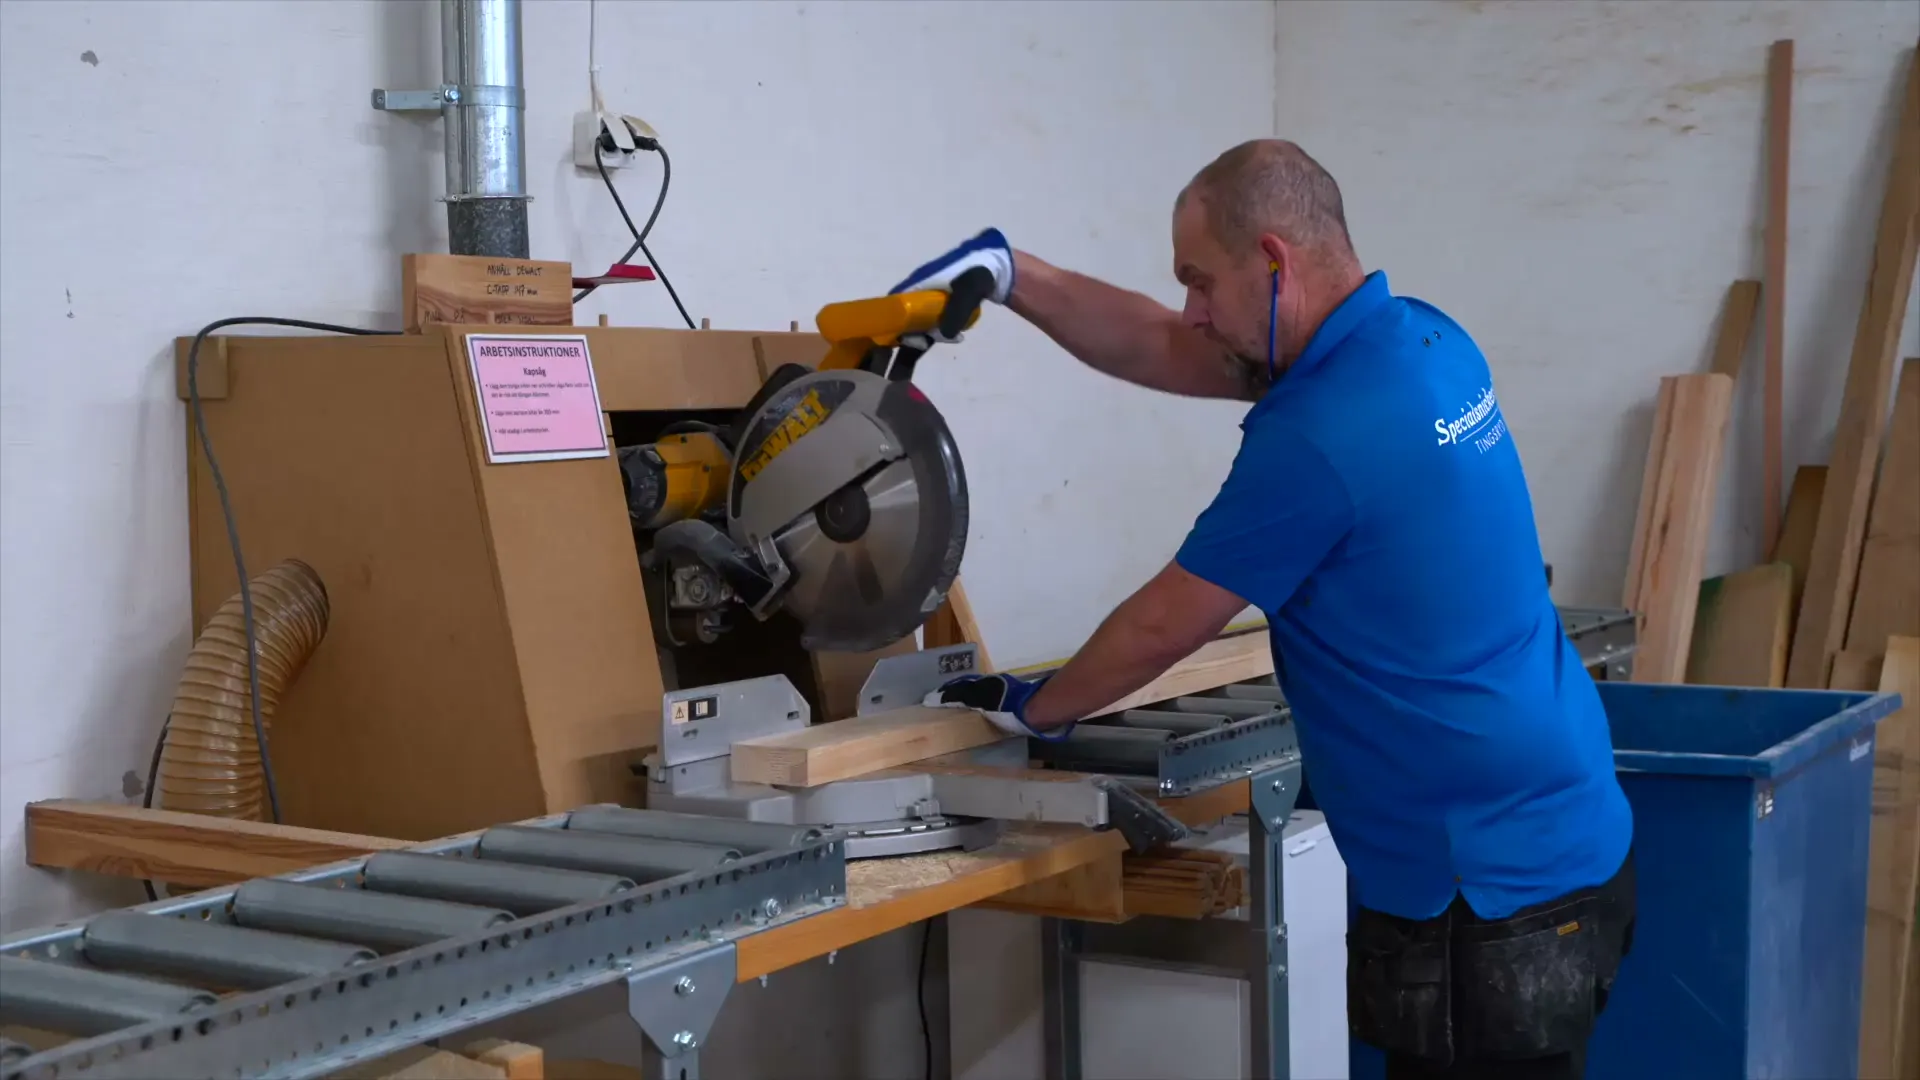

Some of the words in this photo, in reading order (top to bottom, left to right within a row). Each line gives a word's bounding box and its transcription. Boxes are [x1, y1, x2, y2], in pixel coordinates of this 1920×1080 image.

[516, 265, 543, 276] DEWALT
[480, 346, 581, 357] ARBETSINSTRUKTIONER
[523, 366, 547, 377] Kapsåg
